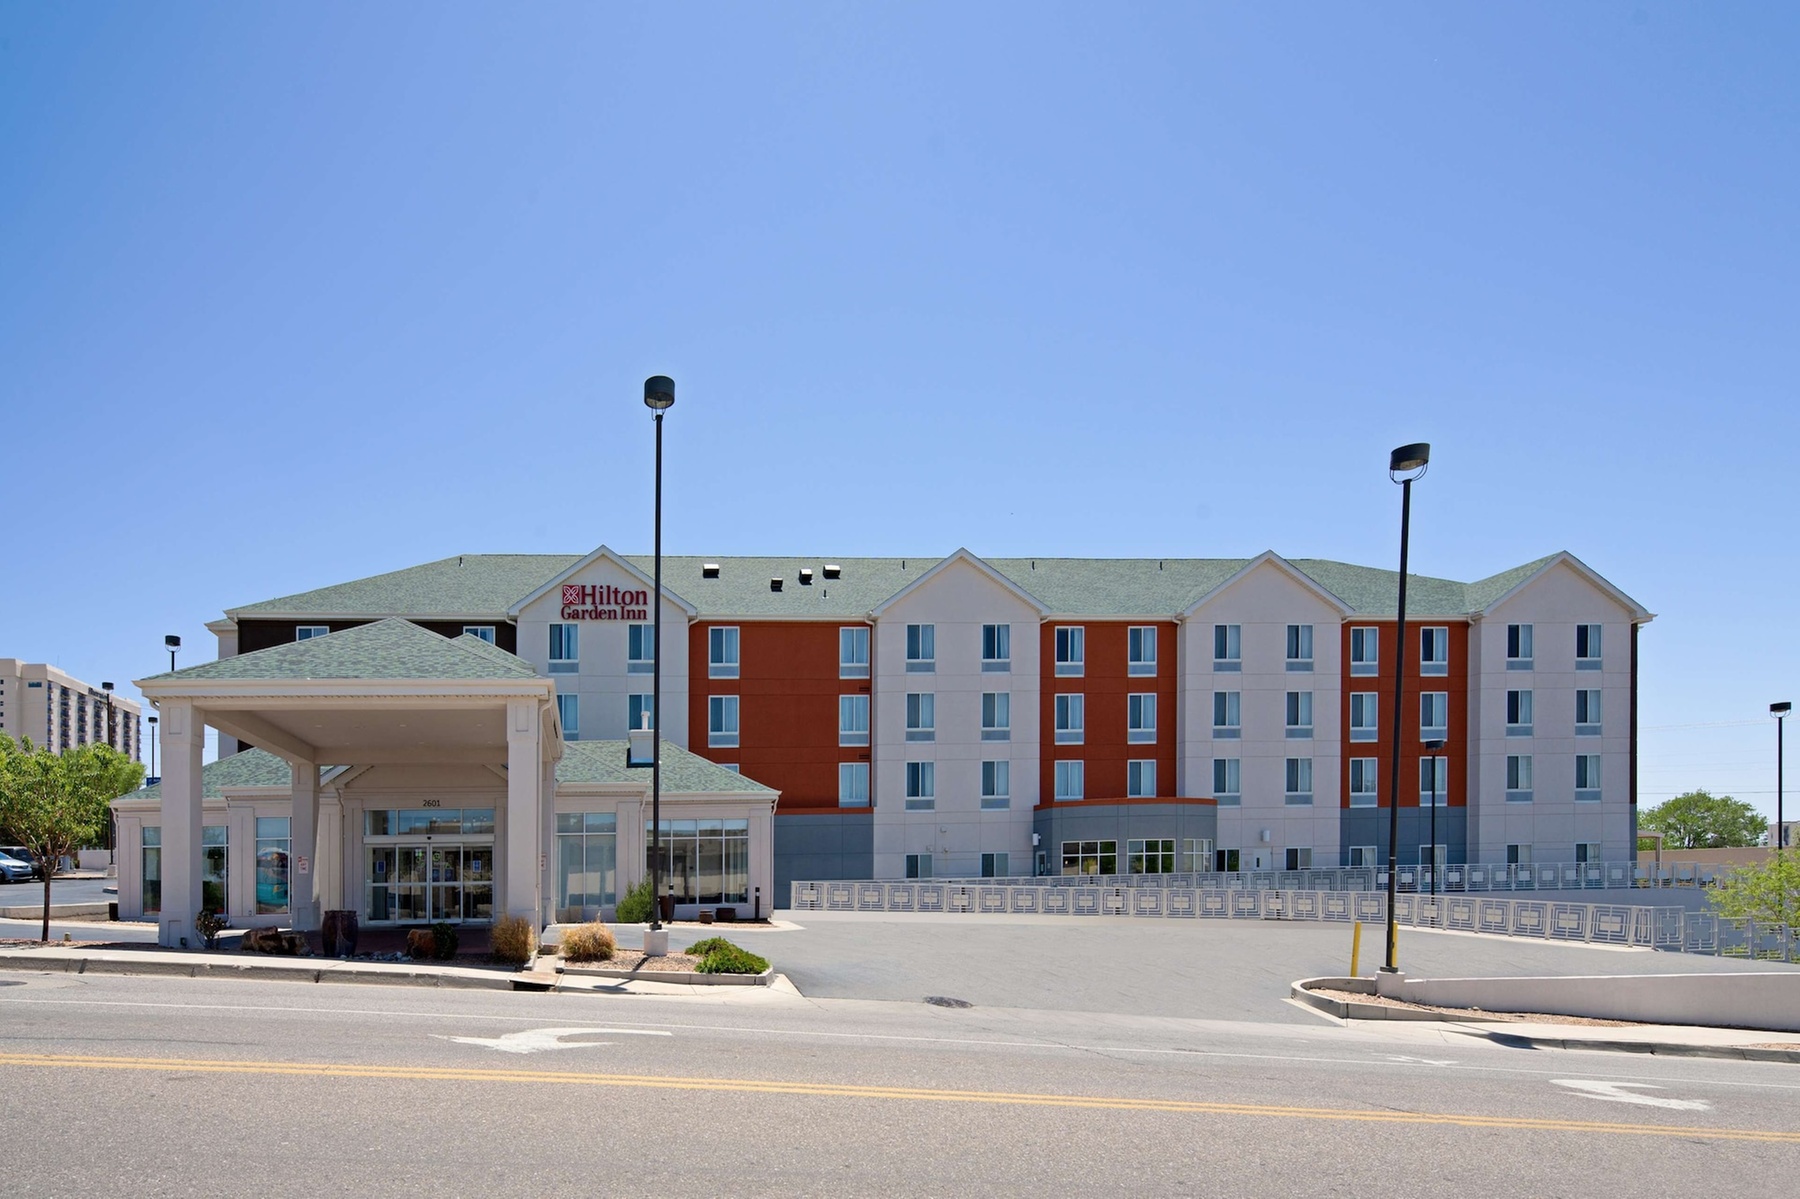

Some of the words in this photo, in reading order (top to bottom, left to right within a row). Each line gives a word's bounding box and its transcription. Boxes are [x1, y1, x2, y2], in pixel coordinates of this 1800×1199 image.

[580, 585, 648, 605] Hilton
[561, 605, 617, 620] Garden
[620, 605, 647, 620] Inn
[422, 799, 441, 807] 2601
